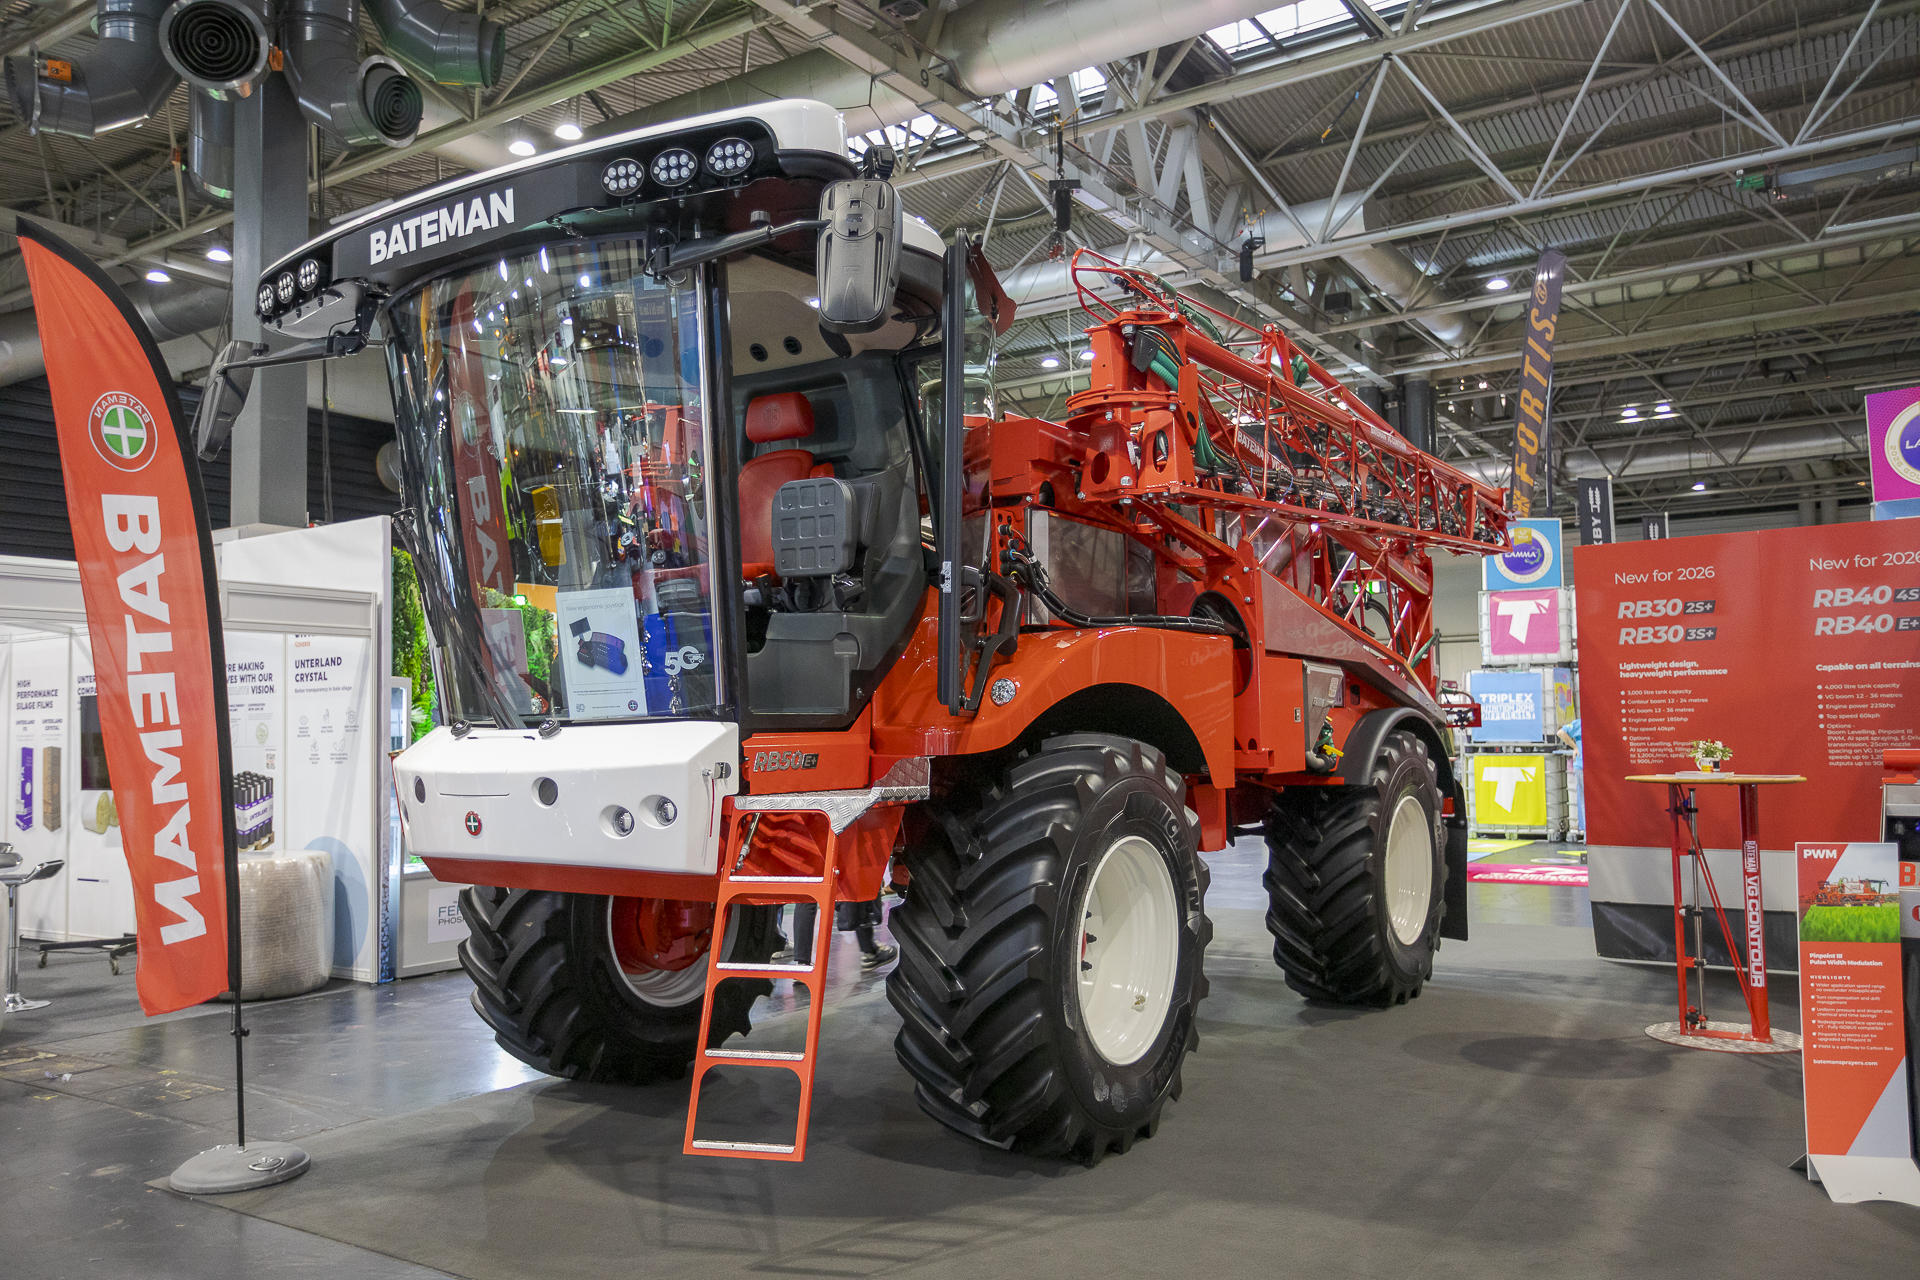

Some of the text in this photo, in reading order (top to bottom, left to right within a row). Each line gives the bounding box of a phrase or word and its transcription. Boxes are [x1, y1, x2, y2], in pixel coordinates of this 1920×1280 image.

[370, 187, 514, 265] BATEMAN
[1890, 445, 1902, 468] 2026
[1810, 558, 1849, 571] New
[1854, 555, 1877, 567] for
[1615, 566, 1715, 584] New for 2026
[1813, 585, 1920, 608] RB40 4S
[604, 602, 625, 610] joystick
[1617, 598, 1712, 619] RB30 2S+
[1815, 614, 1919, 635] RB40 E+
[1619, 625, 1714, 645] RB30 3S+
[238, 662, 264, 671] MAKING
[295, 657, 342, 668] UNTERLAND
[1619, 660, 1698, 670] Lightweight design,
[1816, 663, 1854, 672] Capable
[240, 673, 273, 683] WITH OUR
[295, 672, 327, 682] CRYSTAL
[1620, 669, 1728, 679] heavyweight performance
[17, 689, 58, 698] PERFORMANCE
[1479, 693, 1533, 703] TRIPLEX
[17, 701, 53, 710] SILAGE FILMS
[753, 750, 803, 772] RB50
[1803, 849, 1837, 858] PWM
[1744, 840, 1765, 987] BATEMAN VG CONTOUR
